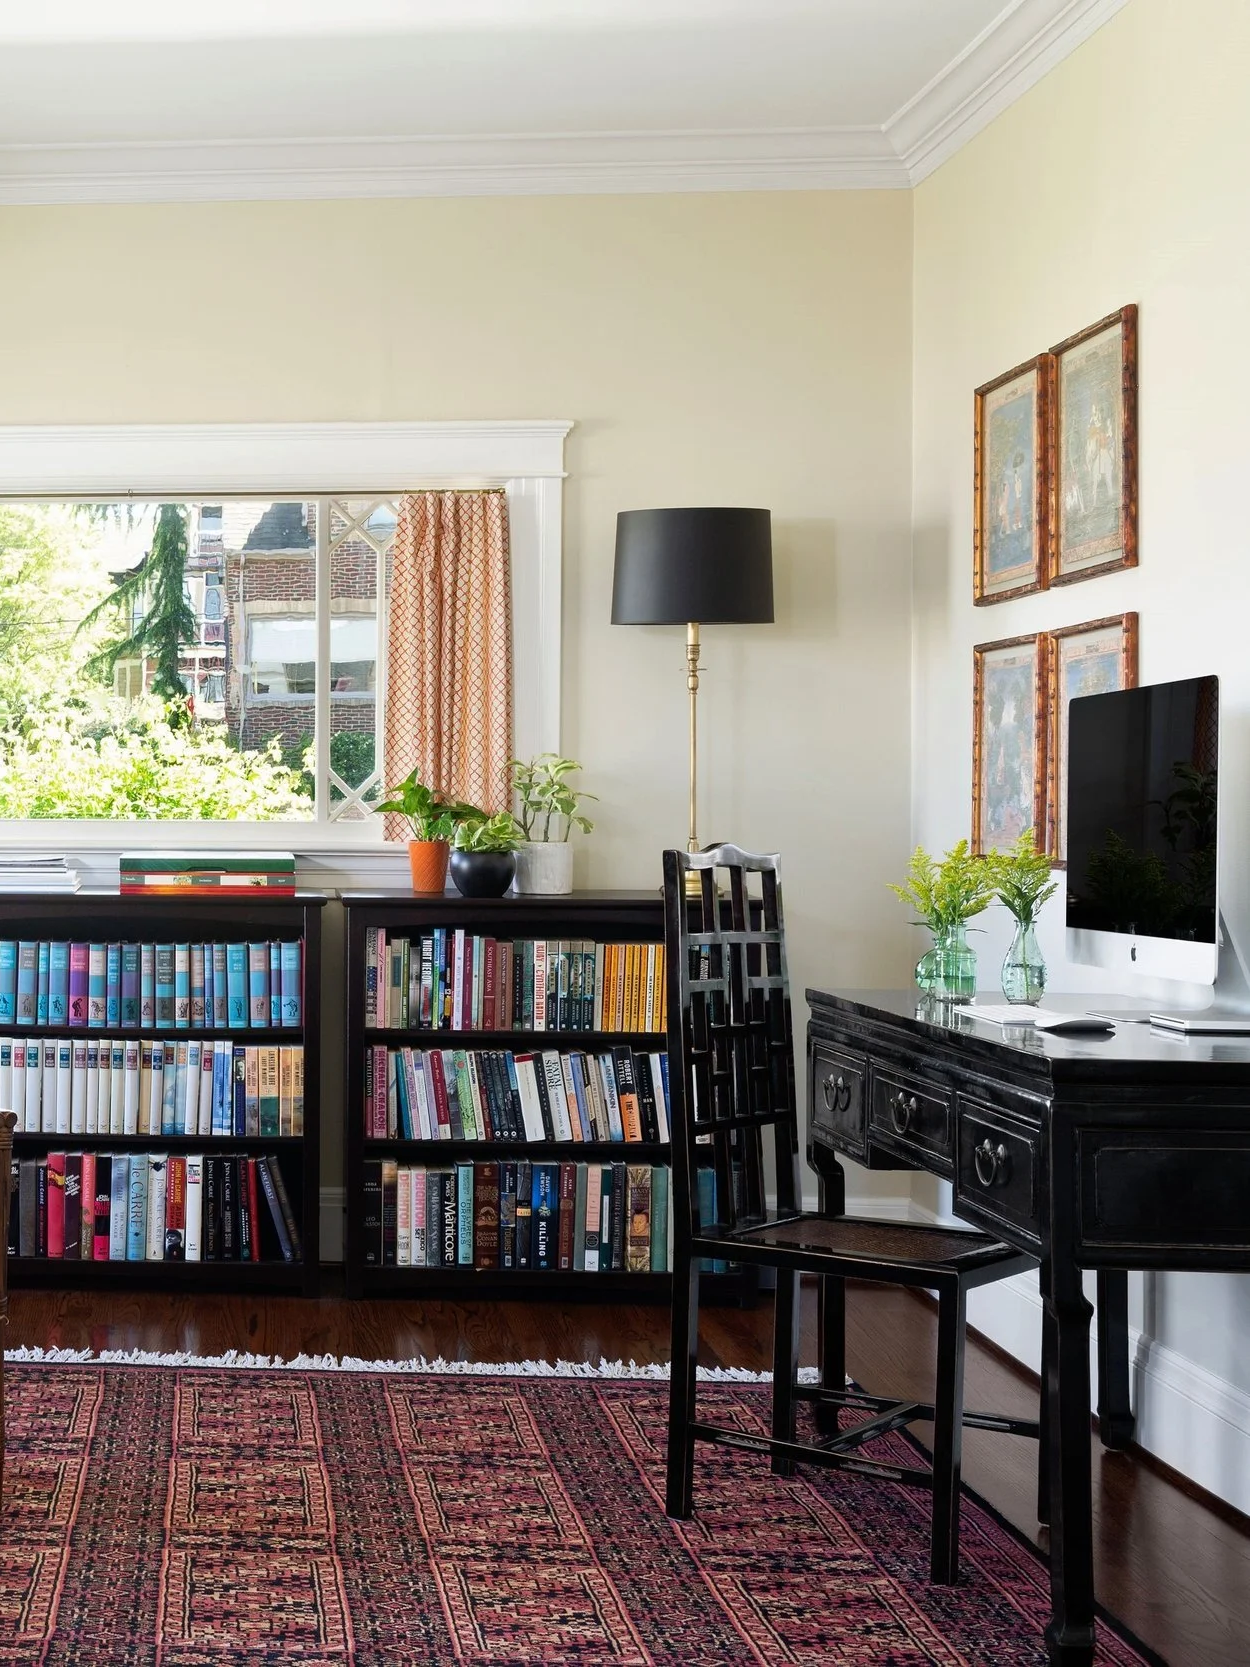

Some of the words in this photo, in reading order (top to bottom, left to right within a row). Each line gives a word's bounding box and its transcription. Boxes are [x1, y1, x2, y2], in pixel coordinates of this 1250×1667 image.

[422, 939, 432, 961] NIGHT
[536, 945, 544, 962] RUBY
[422, 962, 432, 985] HERON
[536, 970, 544, 1000] CYNTHIA
[378, 1050, 386, 1090] MICHAEL
[545, 1059, 555, 1090] SHORE
[552, 1062, 562, 1089] FATAL
[604, 1065, 612, 1079] IAN
[617, 1060, 625, 1086] LITTELL
[624, 1059, 633, 1084] ROBERT
[606, 1079, 616, 1109] RANKIN
[625, 1101, 634, 1111] THE
[378, 1091, 386, 1130] CHABON
[132, 1167, 145, 1178] le
[207, 1160, 215, 1173] JOHN
[223, 1162, 232, 1176] JOHN
[156, 1178, 164, 1199] JOHN
[174, 1184, 183, 1204] CARRÉ
[240, 1182, 248, 1208] FURST
[258, 1164, 268, 1180] ALAN
[263, 1180, 274, 1200] FURST
[156, 1204, 164, 1212] LE
[399, 1174, 410, 1229] DEIGHTON
[414, 1173, 426, 1228] DEIGHTON
[224, 1210, 232, 1232] MISSION
[444, 1201, 456, 1261] Manticore
[504, 1227, 512, 1256] TOURIST
[538, 1221, 547, 1257] KILLING
